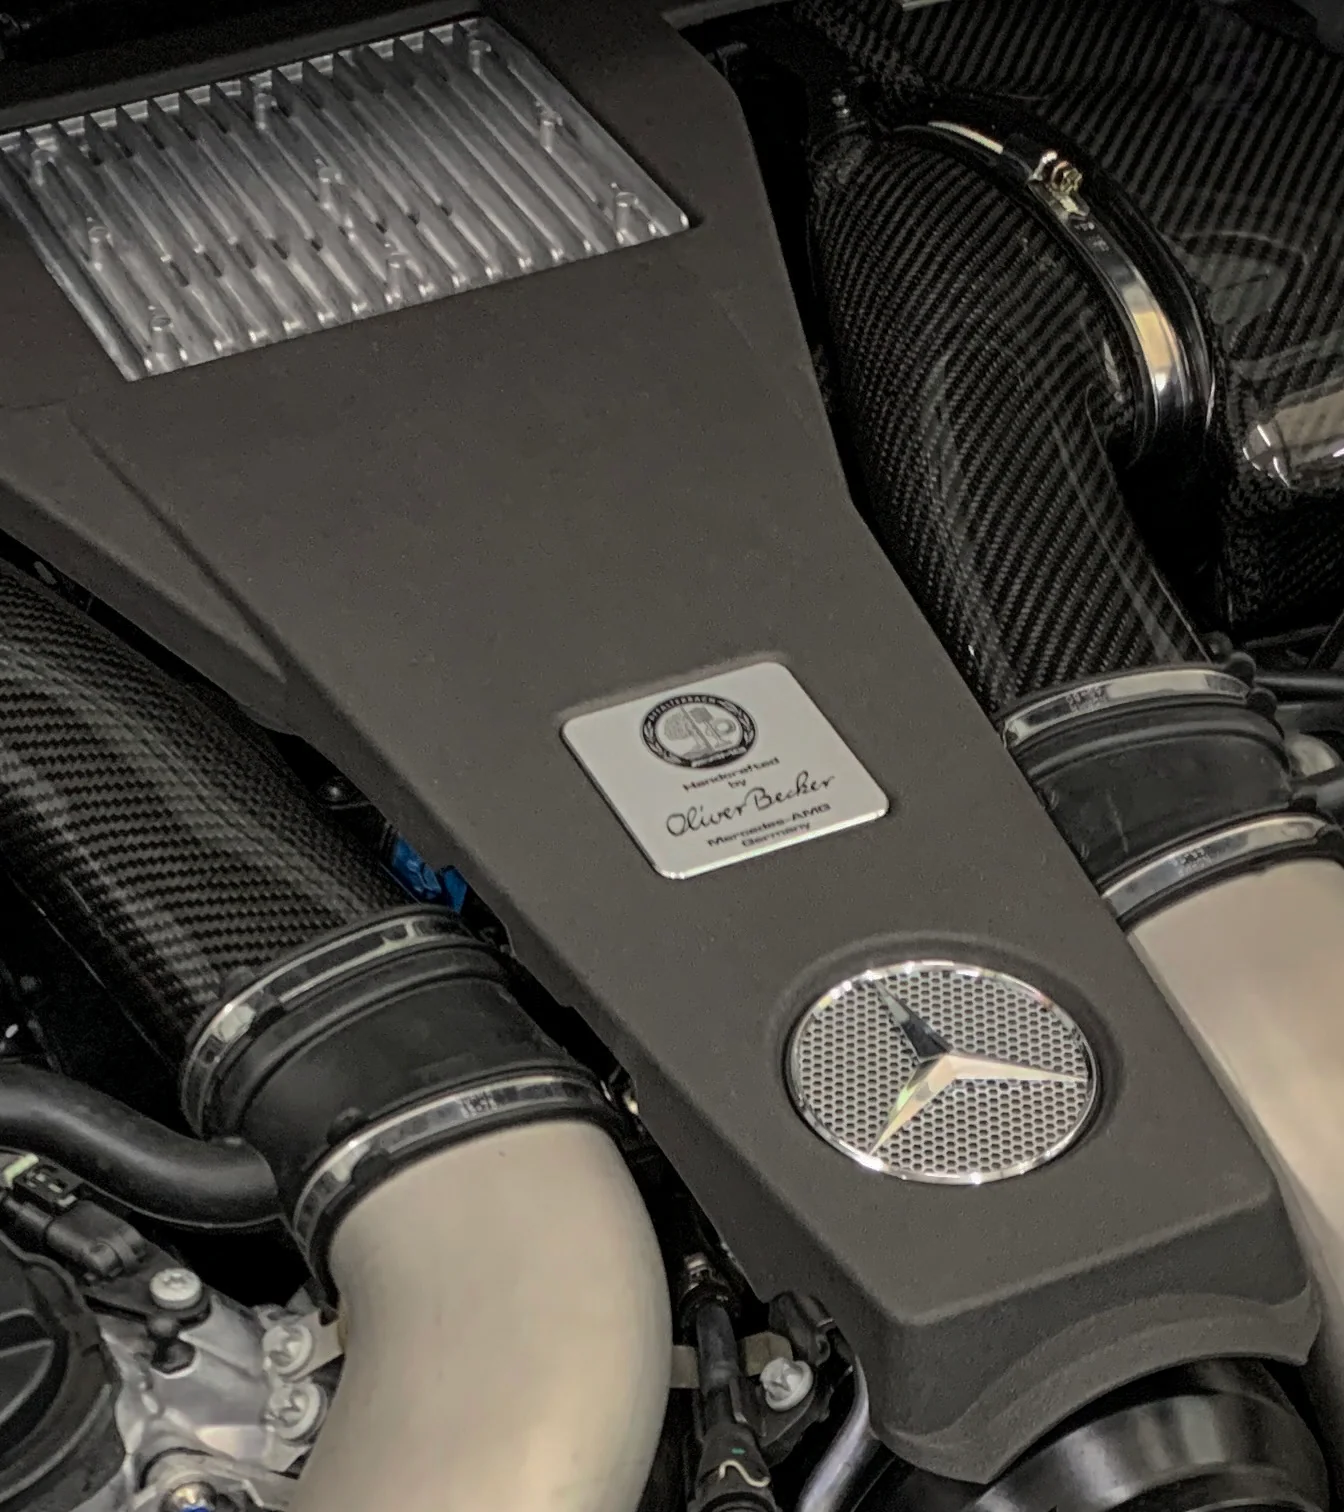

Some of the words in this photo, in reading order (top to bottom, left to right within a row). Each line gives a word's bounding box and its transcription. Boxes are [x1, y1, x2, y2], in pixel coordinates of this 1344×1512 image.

[682, 757, 780, 792] Handcrafted
[728, 778, 747, 790] by
[666, 800, 747, 837] Oliver
[744, 770, 835, 811] Becker
[707, 803, 831, 847] Mercedes-AMG
[741, 823, 810, 847] Germany
